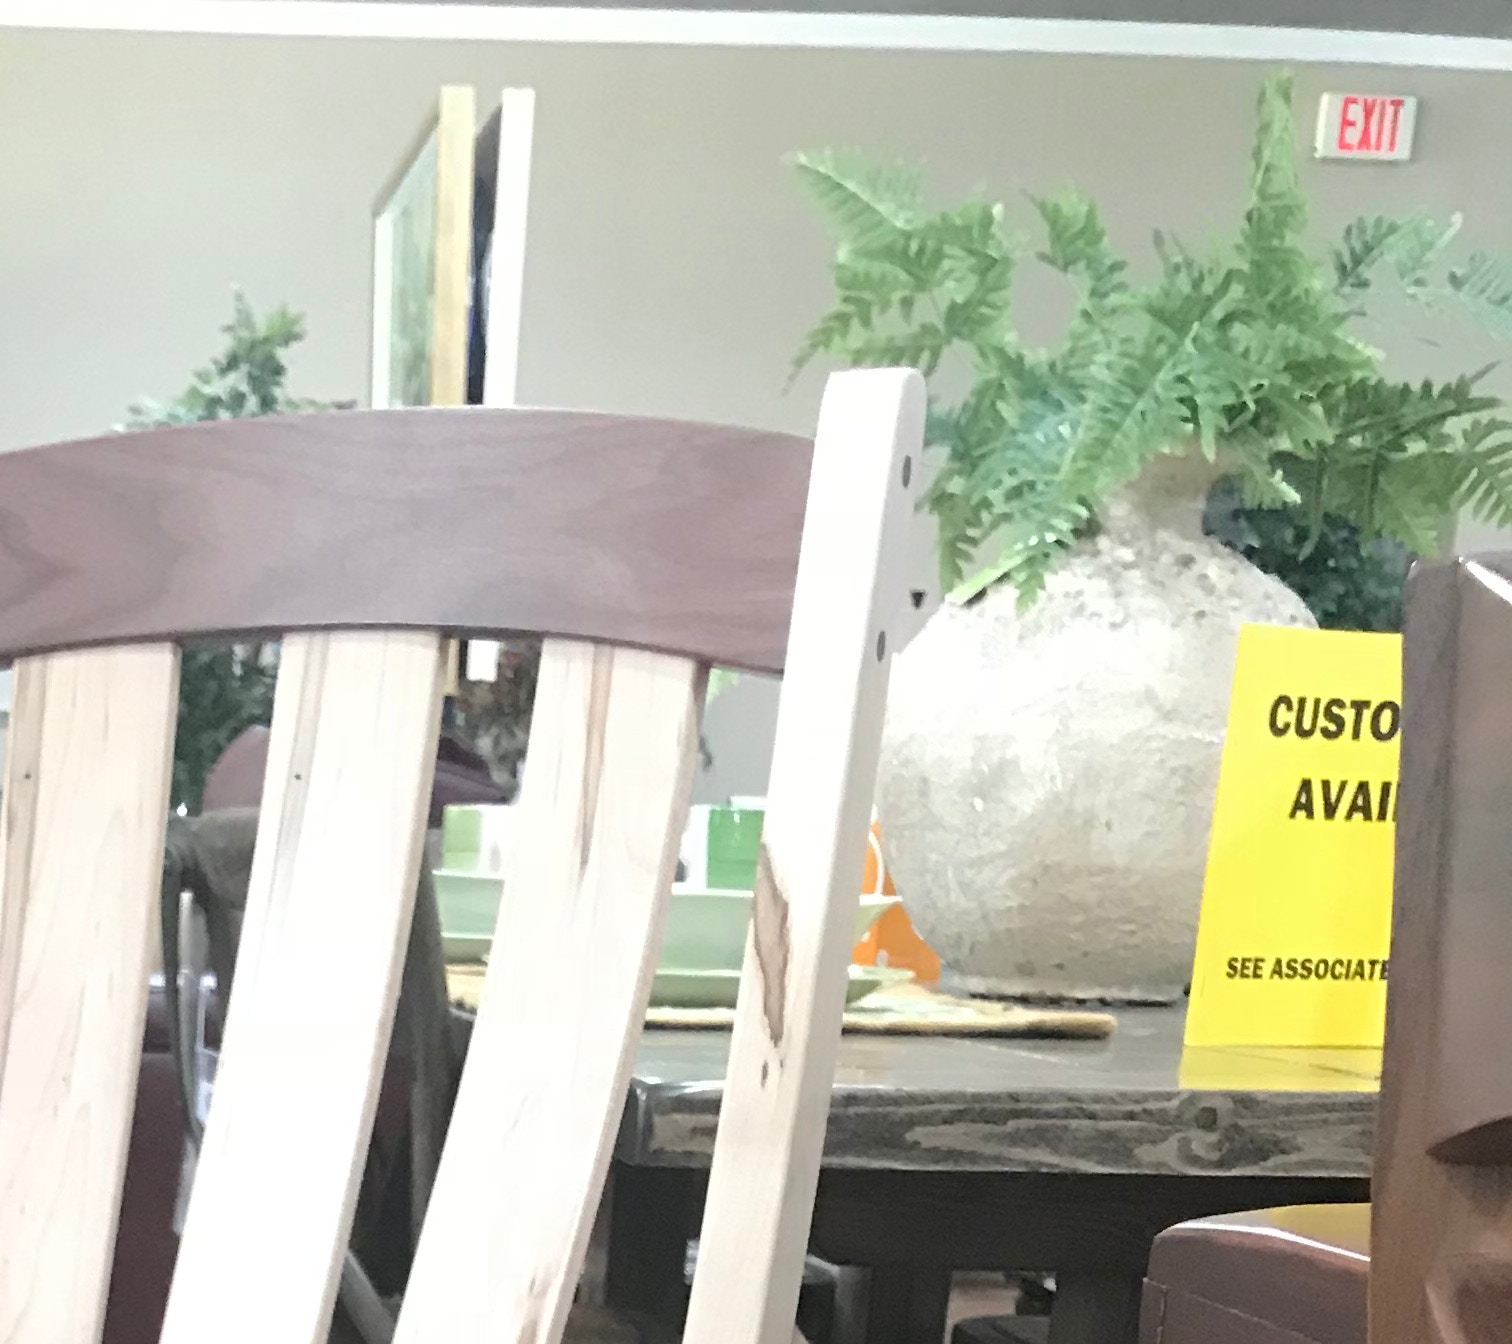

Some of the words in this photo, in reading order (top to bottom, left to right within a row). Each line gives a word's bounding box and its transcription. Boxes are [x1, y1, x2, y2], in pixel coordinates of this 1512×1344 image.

[1338, 96, 1405, 152] EXIT
[1288, 778, 1397, 822] AVAI
[1226, 957, 1265, 979] SEE
